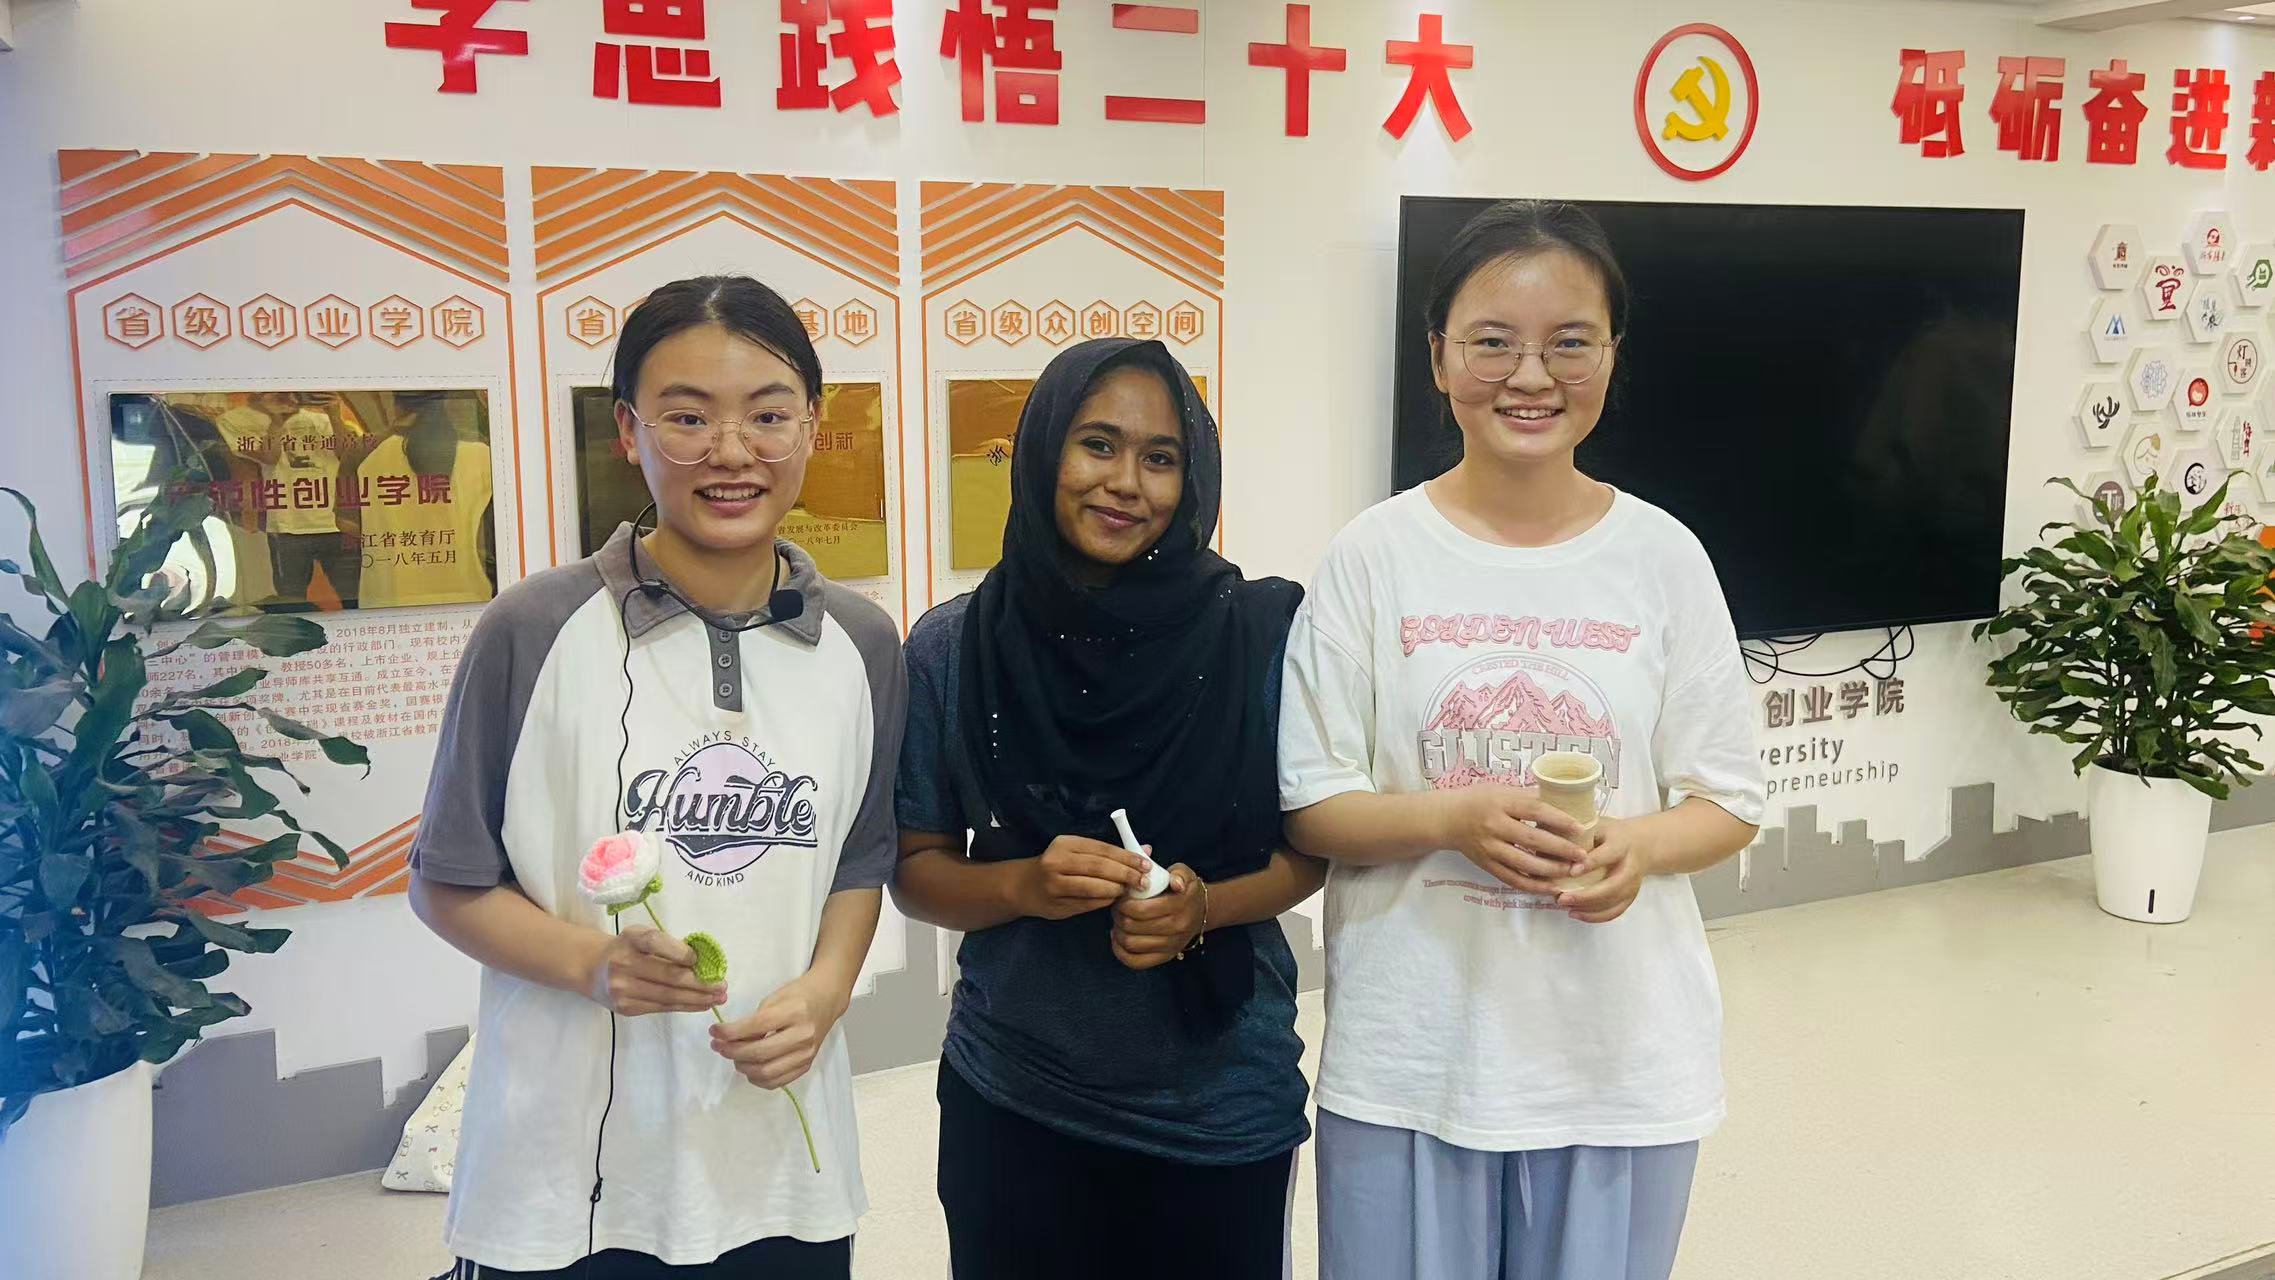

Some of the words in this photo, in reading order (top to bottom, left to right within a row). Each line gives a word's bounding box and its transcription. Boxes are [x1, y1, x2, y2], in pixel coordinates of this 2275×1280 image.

[115, 305, 474, 338] 省级创业学院
[575, 308, 606, 336] 省
[798, 309, 869, 336] 基地
[952, 310, 1196, 336] 省级众创空间
[345, 529, 456, 549] 江省教育厅
[1400, 613, 1542, 657] GOLDEN
[1543, 617, 1641, 653] WEST
[1763, 677, 1905, 729] 创业学院
[674, 730, 732, 766] ALWAYS
[741, 736, 776, 767] STAY
[1767, 760, 1900, 800] preneurship
[624, 766, 818, 836] Humble
[685, 869, 714, 887] AND
[716, 872, 745, 887] KIND
